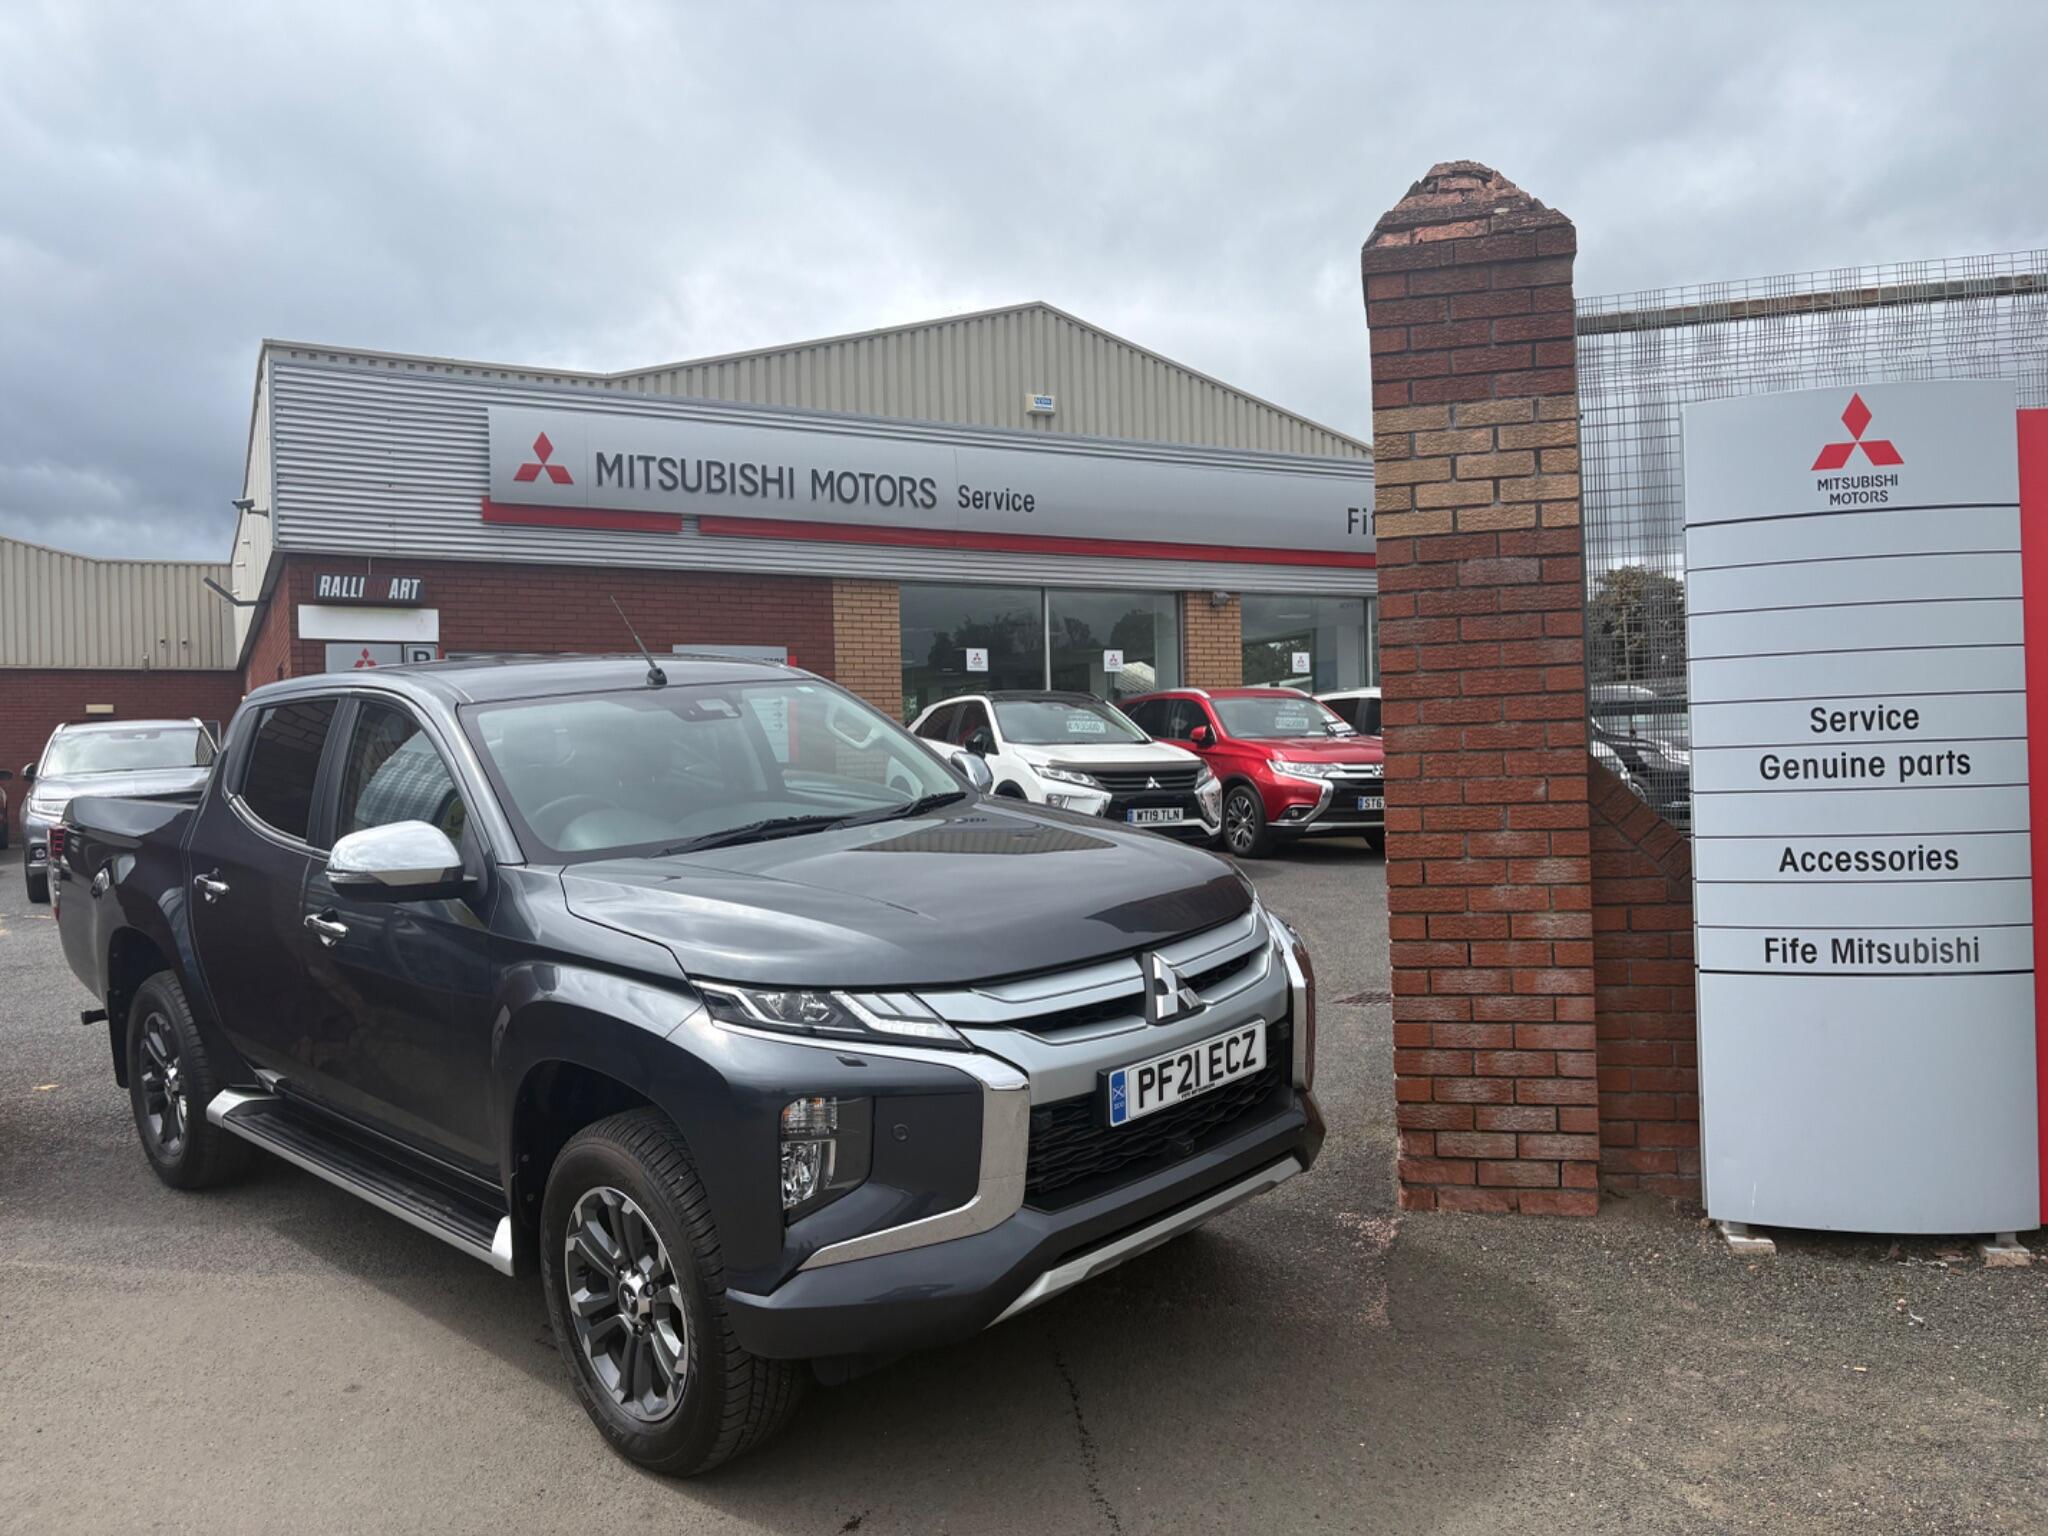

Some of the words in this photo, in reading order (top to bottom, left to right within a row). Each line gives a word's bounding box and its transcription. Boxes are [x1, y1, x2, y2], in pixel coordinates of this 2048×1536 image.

[595, 451, 796, 500] MITSUBISHI
[811, 468, 937, 510] MOTORS
[957, 484, 1036, 513] Service
[1817, 474, 1898, 491] MITSUBISHI
[1829, 490, 1889, 506] MOTORS
[319, 575, 366, 598] RALLI
[388, 578, 421, 600] ART
[1810, 704, 1920, 733] Service
[1759, 751, 1886, 781] Genuine
[1898, 750, 1972, 783] parts
[1778, 844, 1960, 873] Accessories
[1764, 937, 1818, 964] Fife
[1831, 935, 1980, 965] Mitsubishi
[1138, 1049, 1201, 1109] PF21
[1208, 1028, 1257, 1083] ECZ
